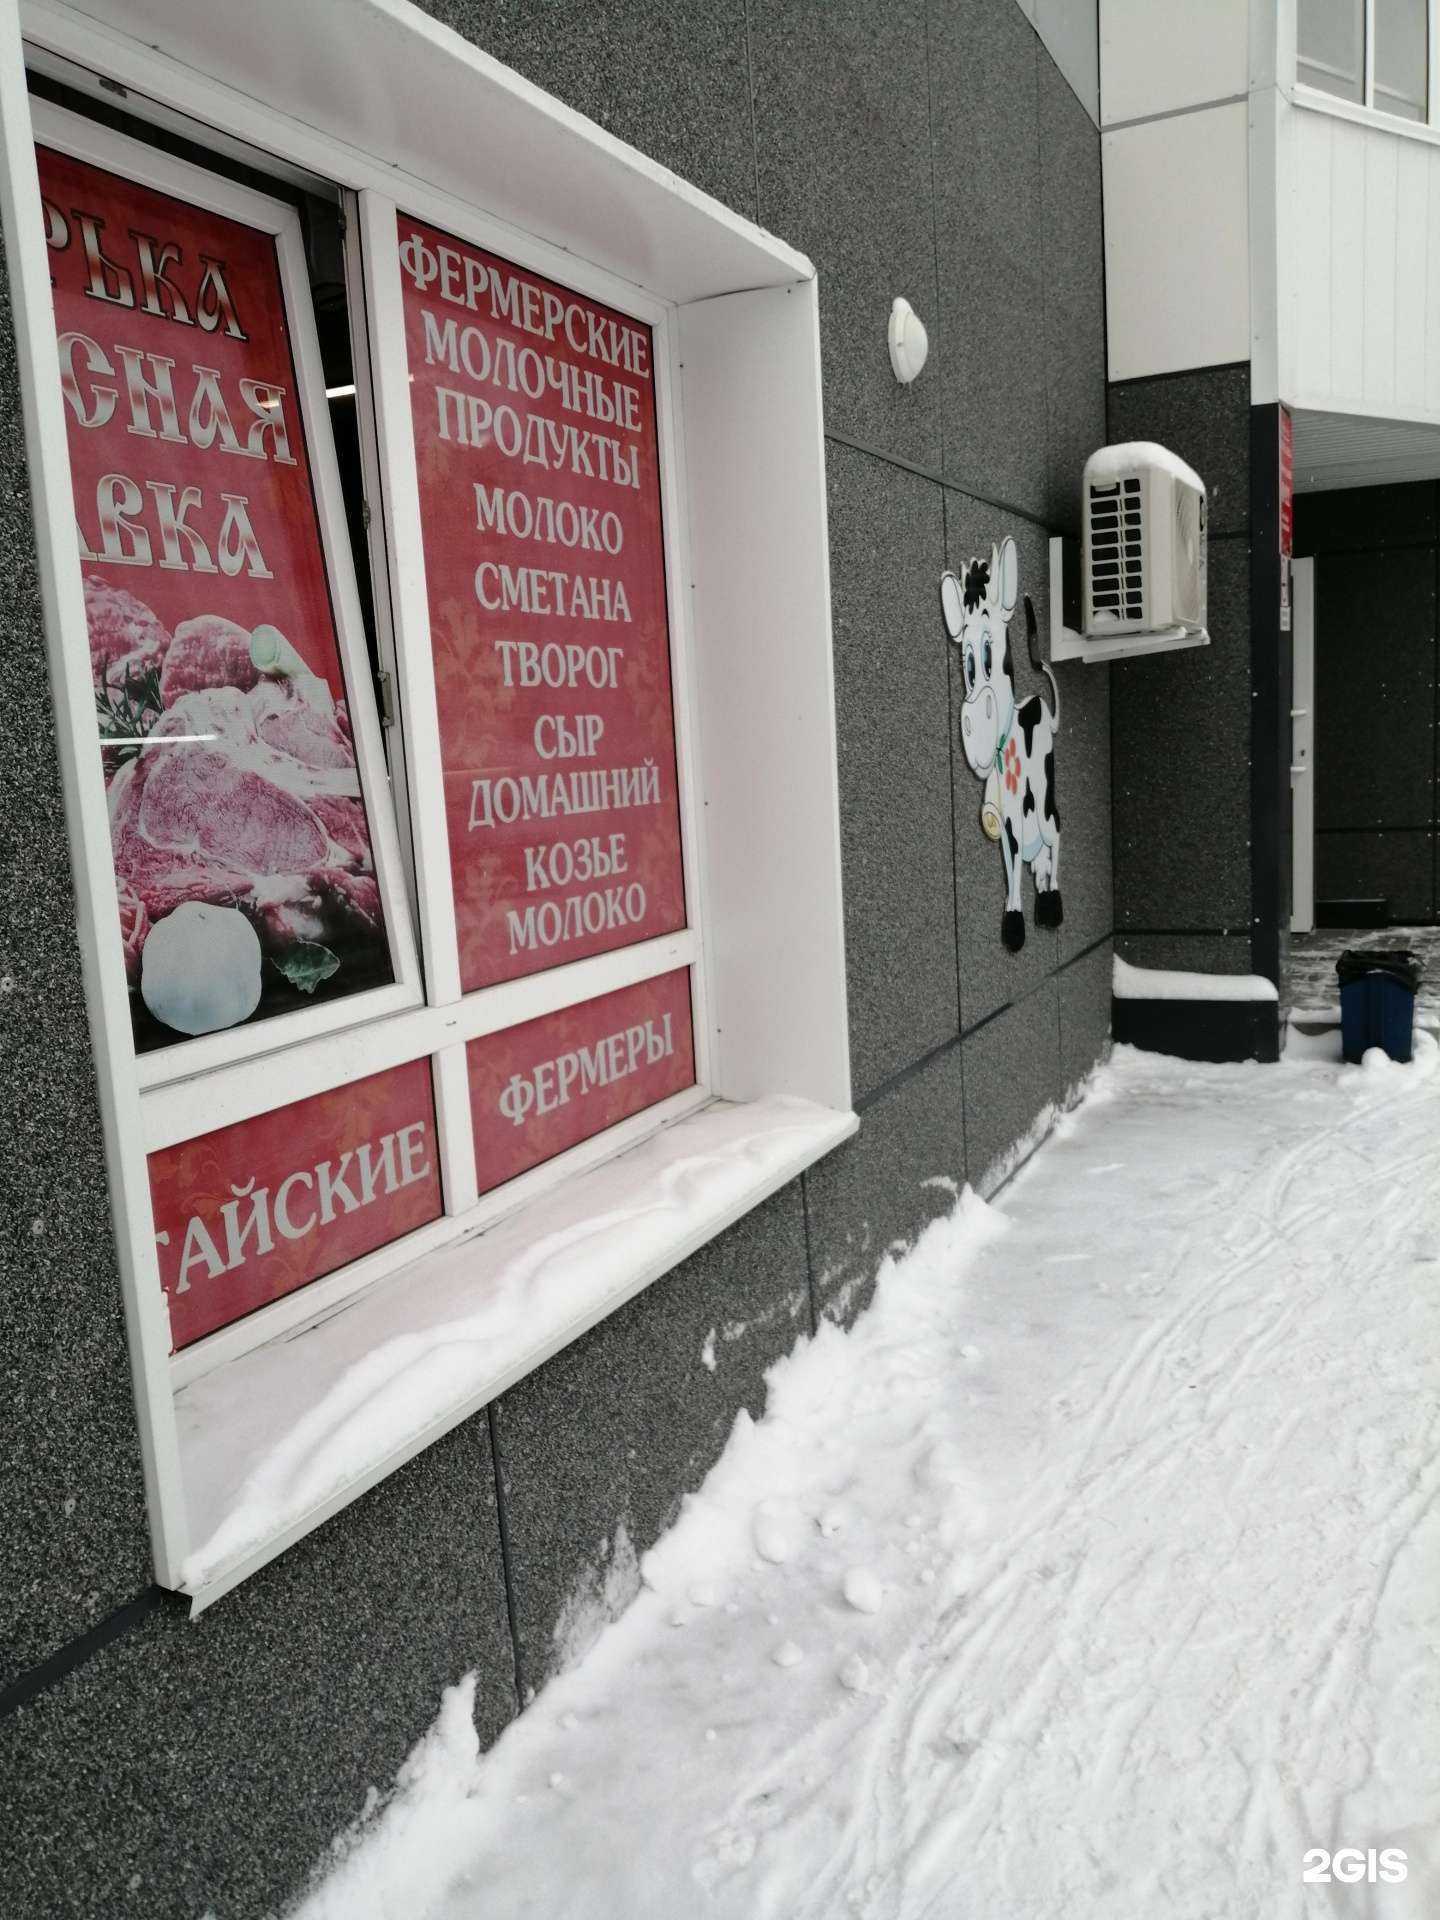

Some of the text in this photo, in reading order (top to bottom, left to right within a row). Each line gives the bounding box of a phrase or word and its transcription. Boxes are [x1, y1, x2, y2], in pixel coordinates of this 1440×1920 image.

[399, 233, 650, 379] ФЕРМЕРСКИЕ
[420, 309, 642, 433] МОЛОЧНЫЕ
[434, 386, 641, 490] ПРОДУКТЫ
[75, 473, 274, 580] ВКА
[472, 482, 624, 556] МОЛОКО
[474, 561, 633, 623] СМЕТАНА
[494, 640, 624, 689] ТВОРОГ
[533, 714, 605, 760] СЫР
[467, 756, 662, 833] ДОМАШНИЙ
[523, 832, 629, 892] КОЗЬЕ
[505, 882, 647, 956] МОЛОКО
[156, 1012, 675, 1294] АЙСКИЕ ФЕРМЕРЫ
